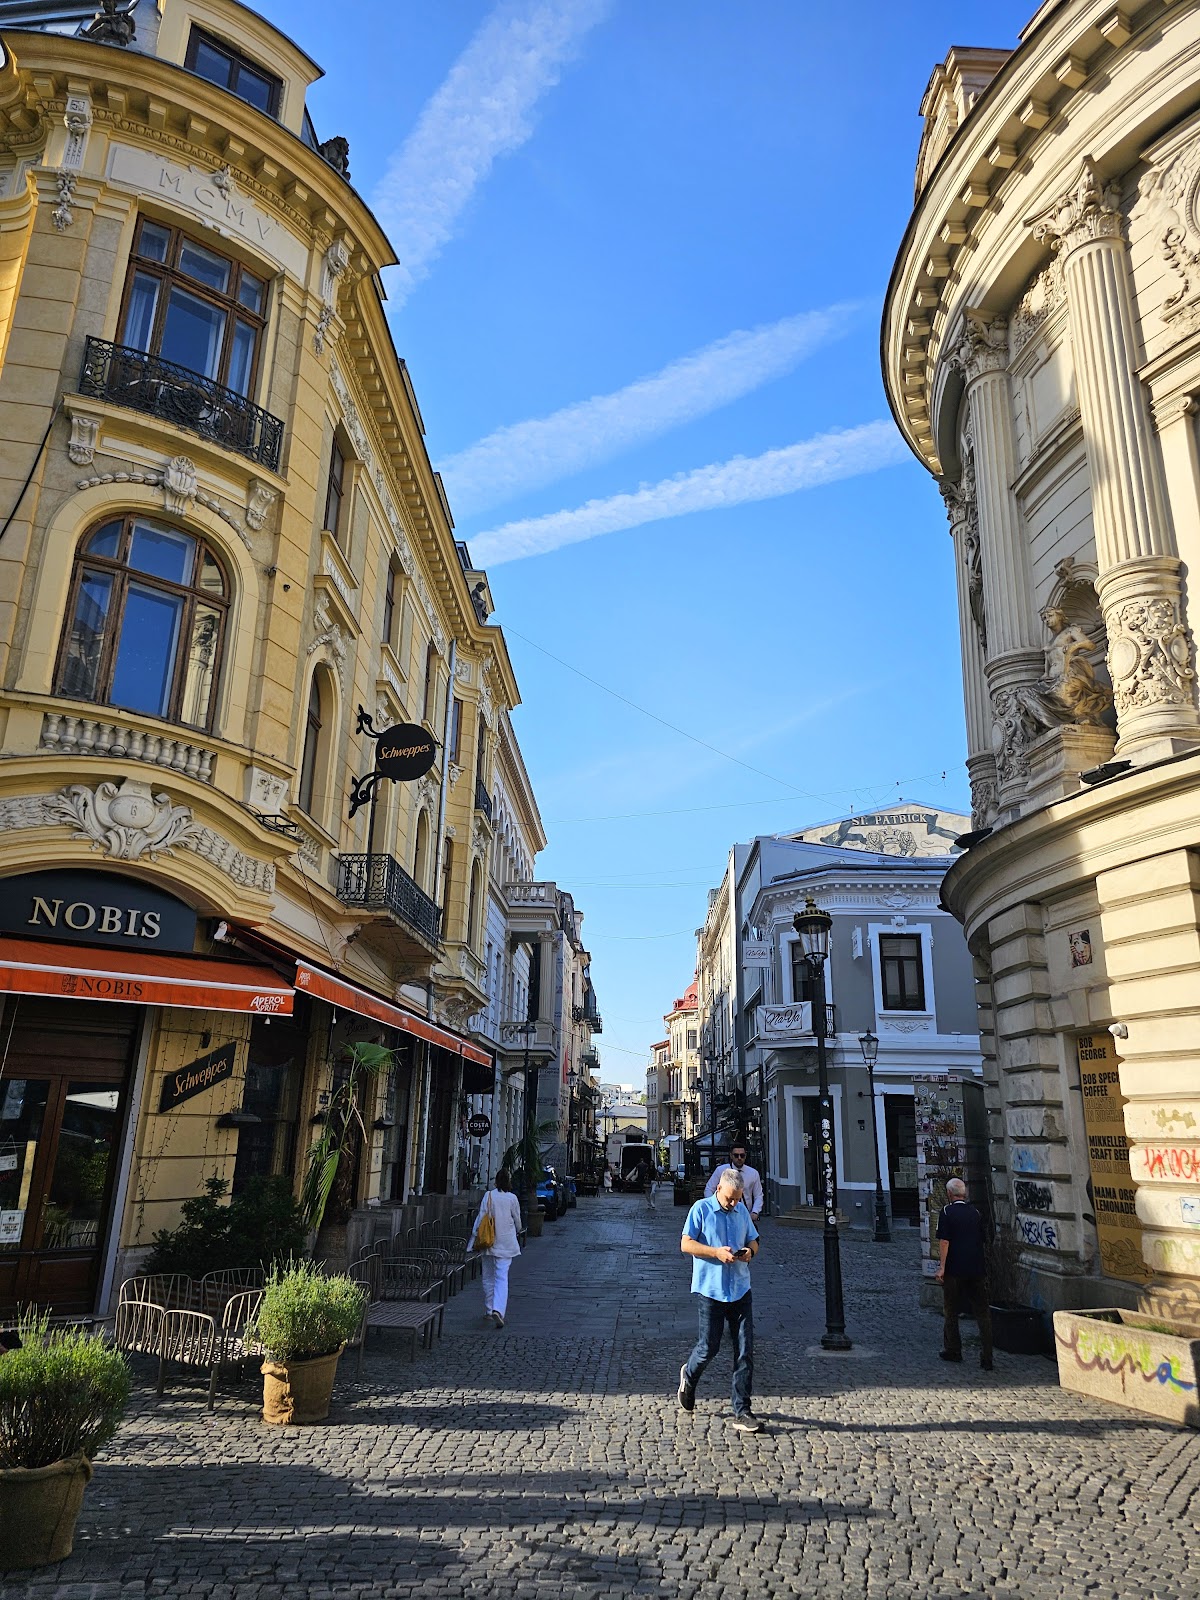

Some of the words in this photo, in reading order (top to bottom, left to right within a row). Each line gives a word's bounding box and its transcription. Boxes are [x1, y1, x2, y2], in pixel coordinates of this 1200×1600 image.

[159, 168, 272, 240] MCMV
[378, 743, 431, 760] Schweppes
[875, 813, 928, 825] PATRICK
[28, 896, 162, 939] NOBIS
[79, 977, 143, 996] NOBIS
[250, 995, 286, 1007] APEROL
[256, 1003, 280, 1012] SPRITZ
[1079, 1036, 1093, 1049] BOB
[1080, 1047, 1107, 1060] GEORGE
[172, 1058, 228, 1097] Schweppes
[1082, 1073, 1097, 1085] BOB
[1084, 1085, 1108, 1097] COFFEE
[1088, 1135, 1127, 1148] MIKKELLER
[1090, 1148, 1112, 1160] CRAFT
[1091, 1160, 1112, 1173] FROM
[1094, 1186, 1117, 1200] MAMA
[1096, 1212, 1119, 1226] FROM
